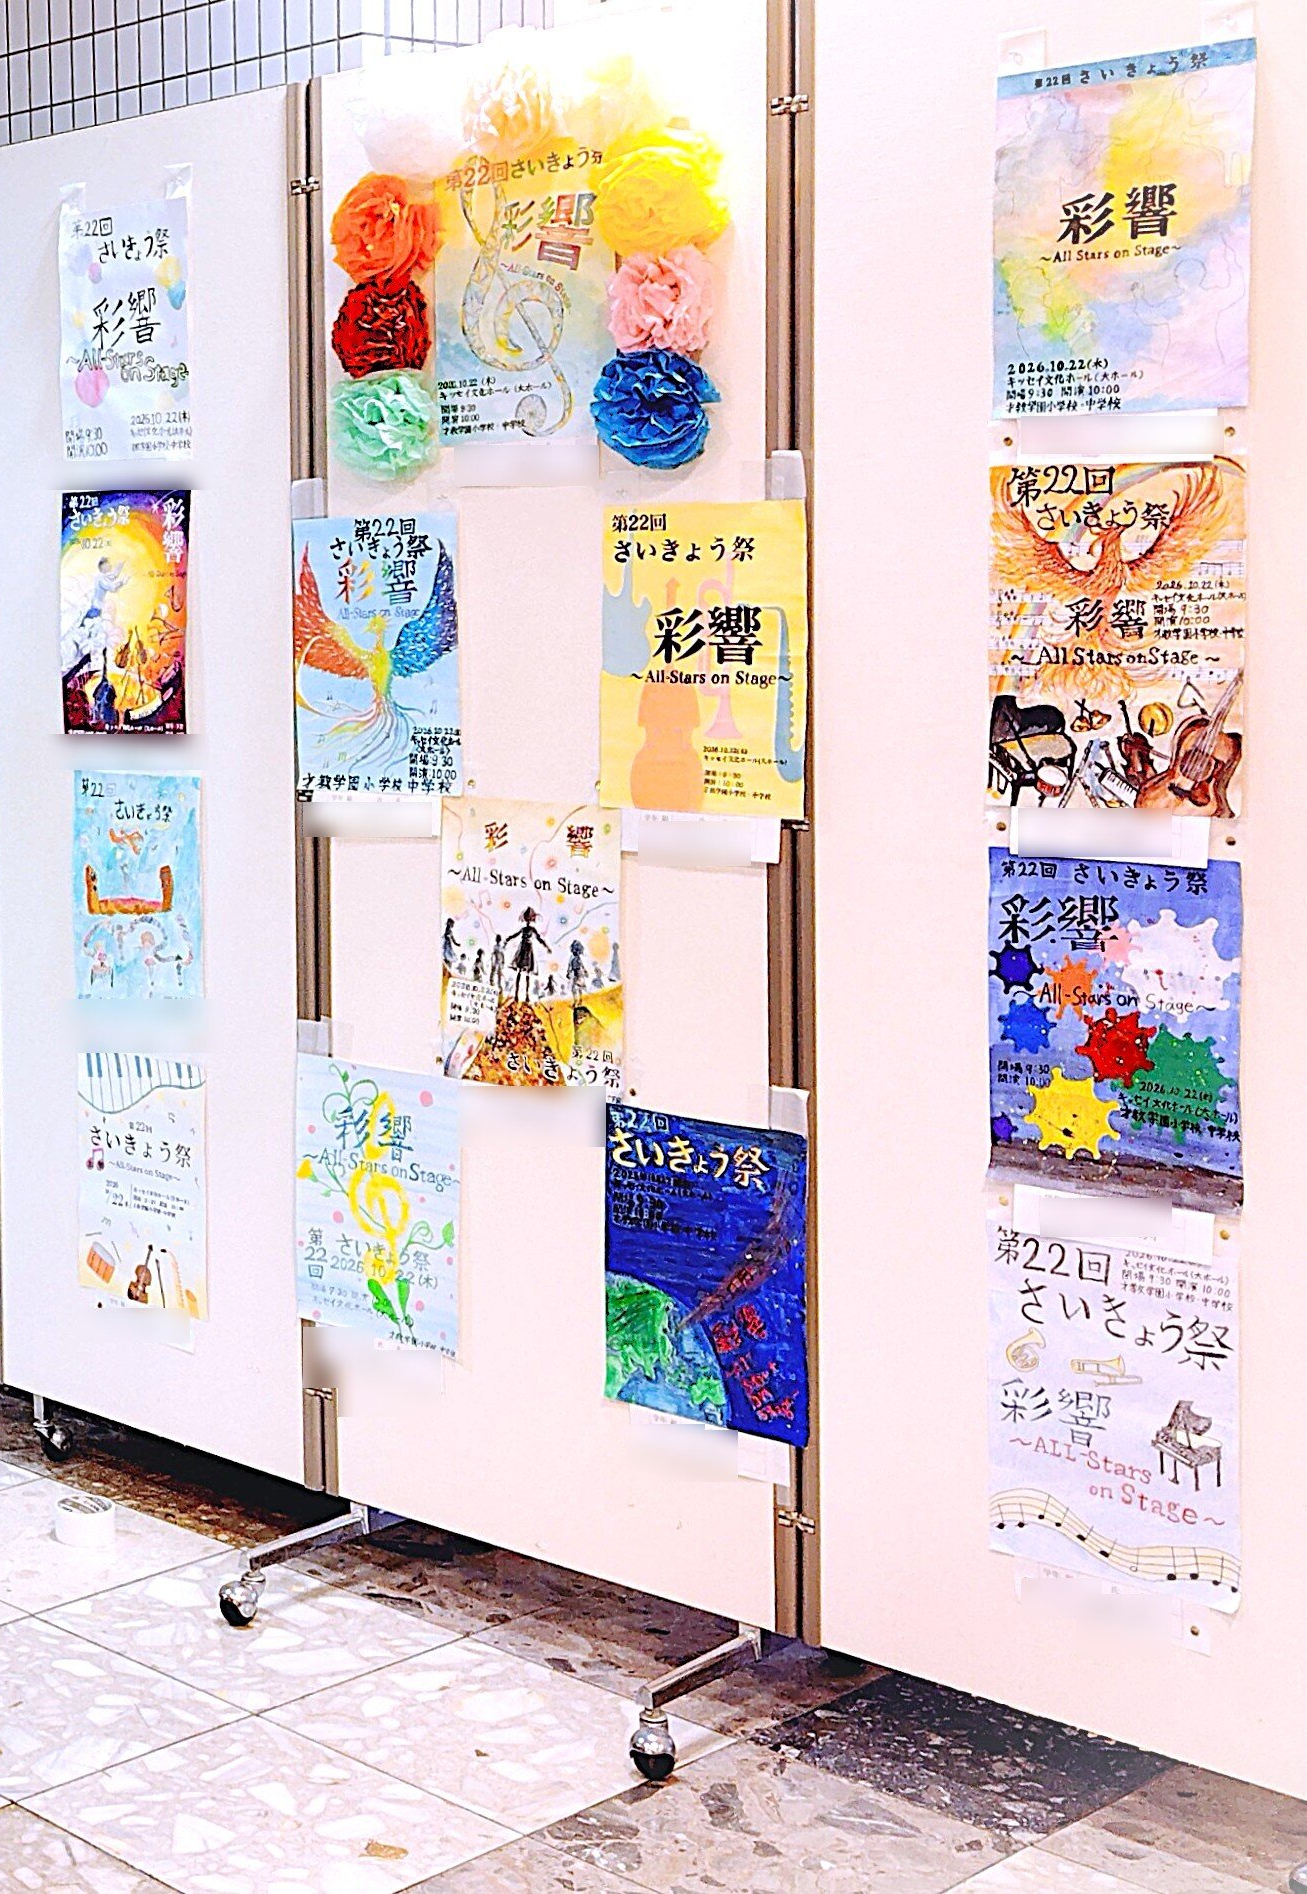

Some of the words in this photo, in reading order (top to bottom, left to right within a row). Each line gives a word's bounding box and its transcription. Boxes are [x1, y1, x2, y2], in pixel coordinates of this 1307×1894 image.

[1080, 51, 1209, 85] さいきょう祭
[500, 193, 598, 271] 彩響
[1056, 182, 1178, 245] 彩響
[98, 228, 171, 264] さいきょう祭
[1114, 248, 1130, 259] on
[92, 287, 161, 350] 彩響
[1009, 464, 1116, 508] 第22回
[354, 518, 416, 543] 第22回
[611, 513, 667, 533] 第22回
[1036, 500, 1172, 532] さいきょう祭
[329, 535, 433, 560] さいきょう祭
[613, 535, 756, 563] さいきょう祭
[334, 557, 418, 606] 彩響
[652, 605, 764, 666] 彩響
[1064, 598, 1150, 640] 彩響
[711, 672, 730, 684] on
[534, 878, 552, 892] on
[1001, 861, 1058, 879] 第22回
[1073, 865, 1208, 895] さいきょう祭
[997, 894, 1119, 952] 彩響
[1117, 994, 1139, 1007] on
[90, 1125, 191, 1168] さいきょう祭
[334, 1105, 414, 1163] 彩響
[391, 1166, 408, 1179] on
[608, 1127, 771, 1191] さいきょう祭
[336, 1233, 431, 1272] さいきょう祭
[994, 1226, 1112, 1286] 第22回
[1018, 1278, 1235, 1372] さいきょう祭
[1000, 1378, 1112, 1448] 彩響
[1089, 1484, 1113, 1499] on
